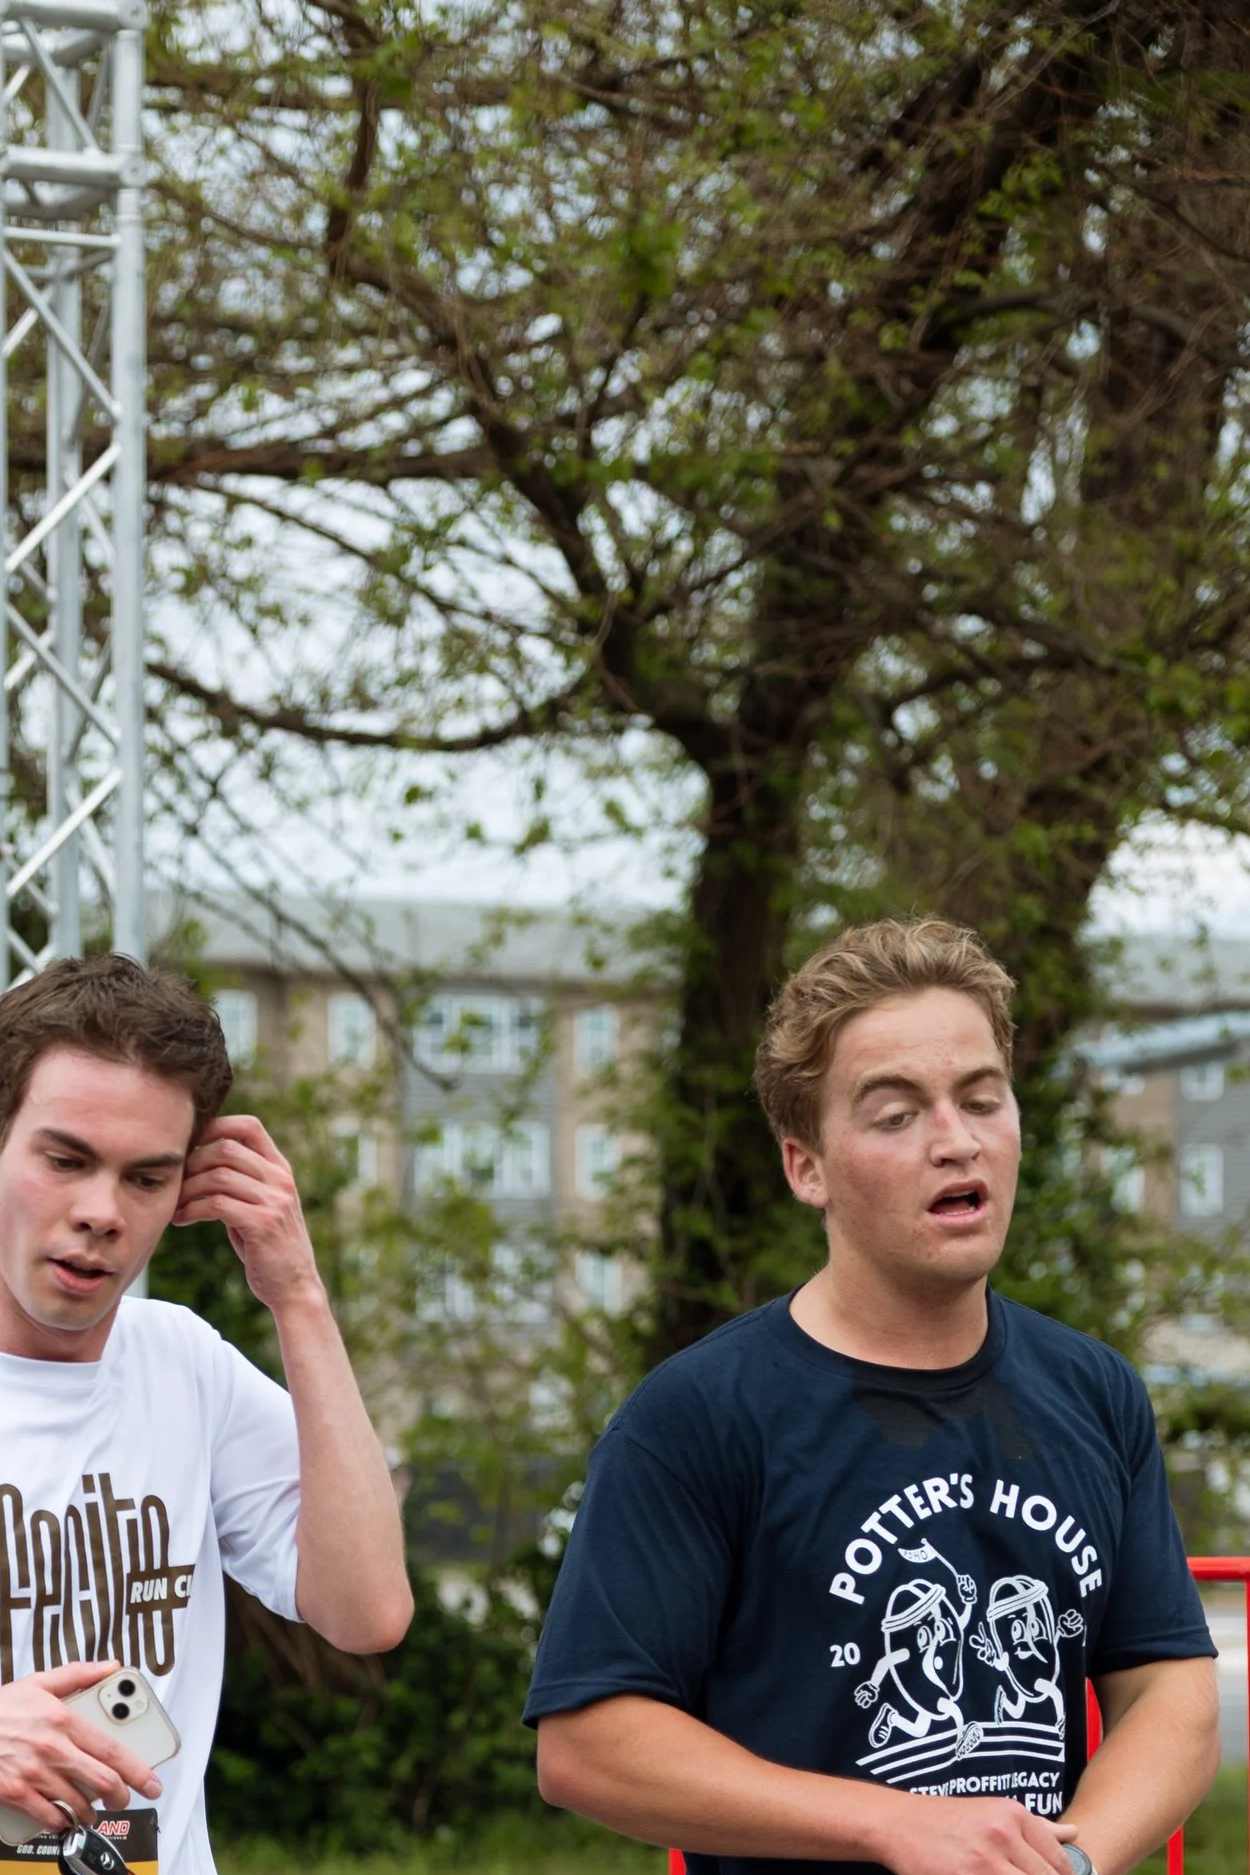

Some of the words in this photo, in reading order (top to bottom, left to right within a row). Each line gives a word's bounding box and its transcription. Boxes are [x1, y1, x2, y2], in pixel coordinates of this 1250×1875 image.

[828, 1472, 974, 1605] POTTER'S
[989, 1478, 1103, 1598] HOUSE
[130, 1577, 168, 1604] RUN
[829, 1641, 861, 1668] 20
[1024, 1791, 1063, 1816] FUN
